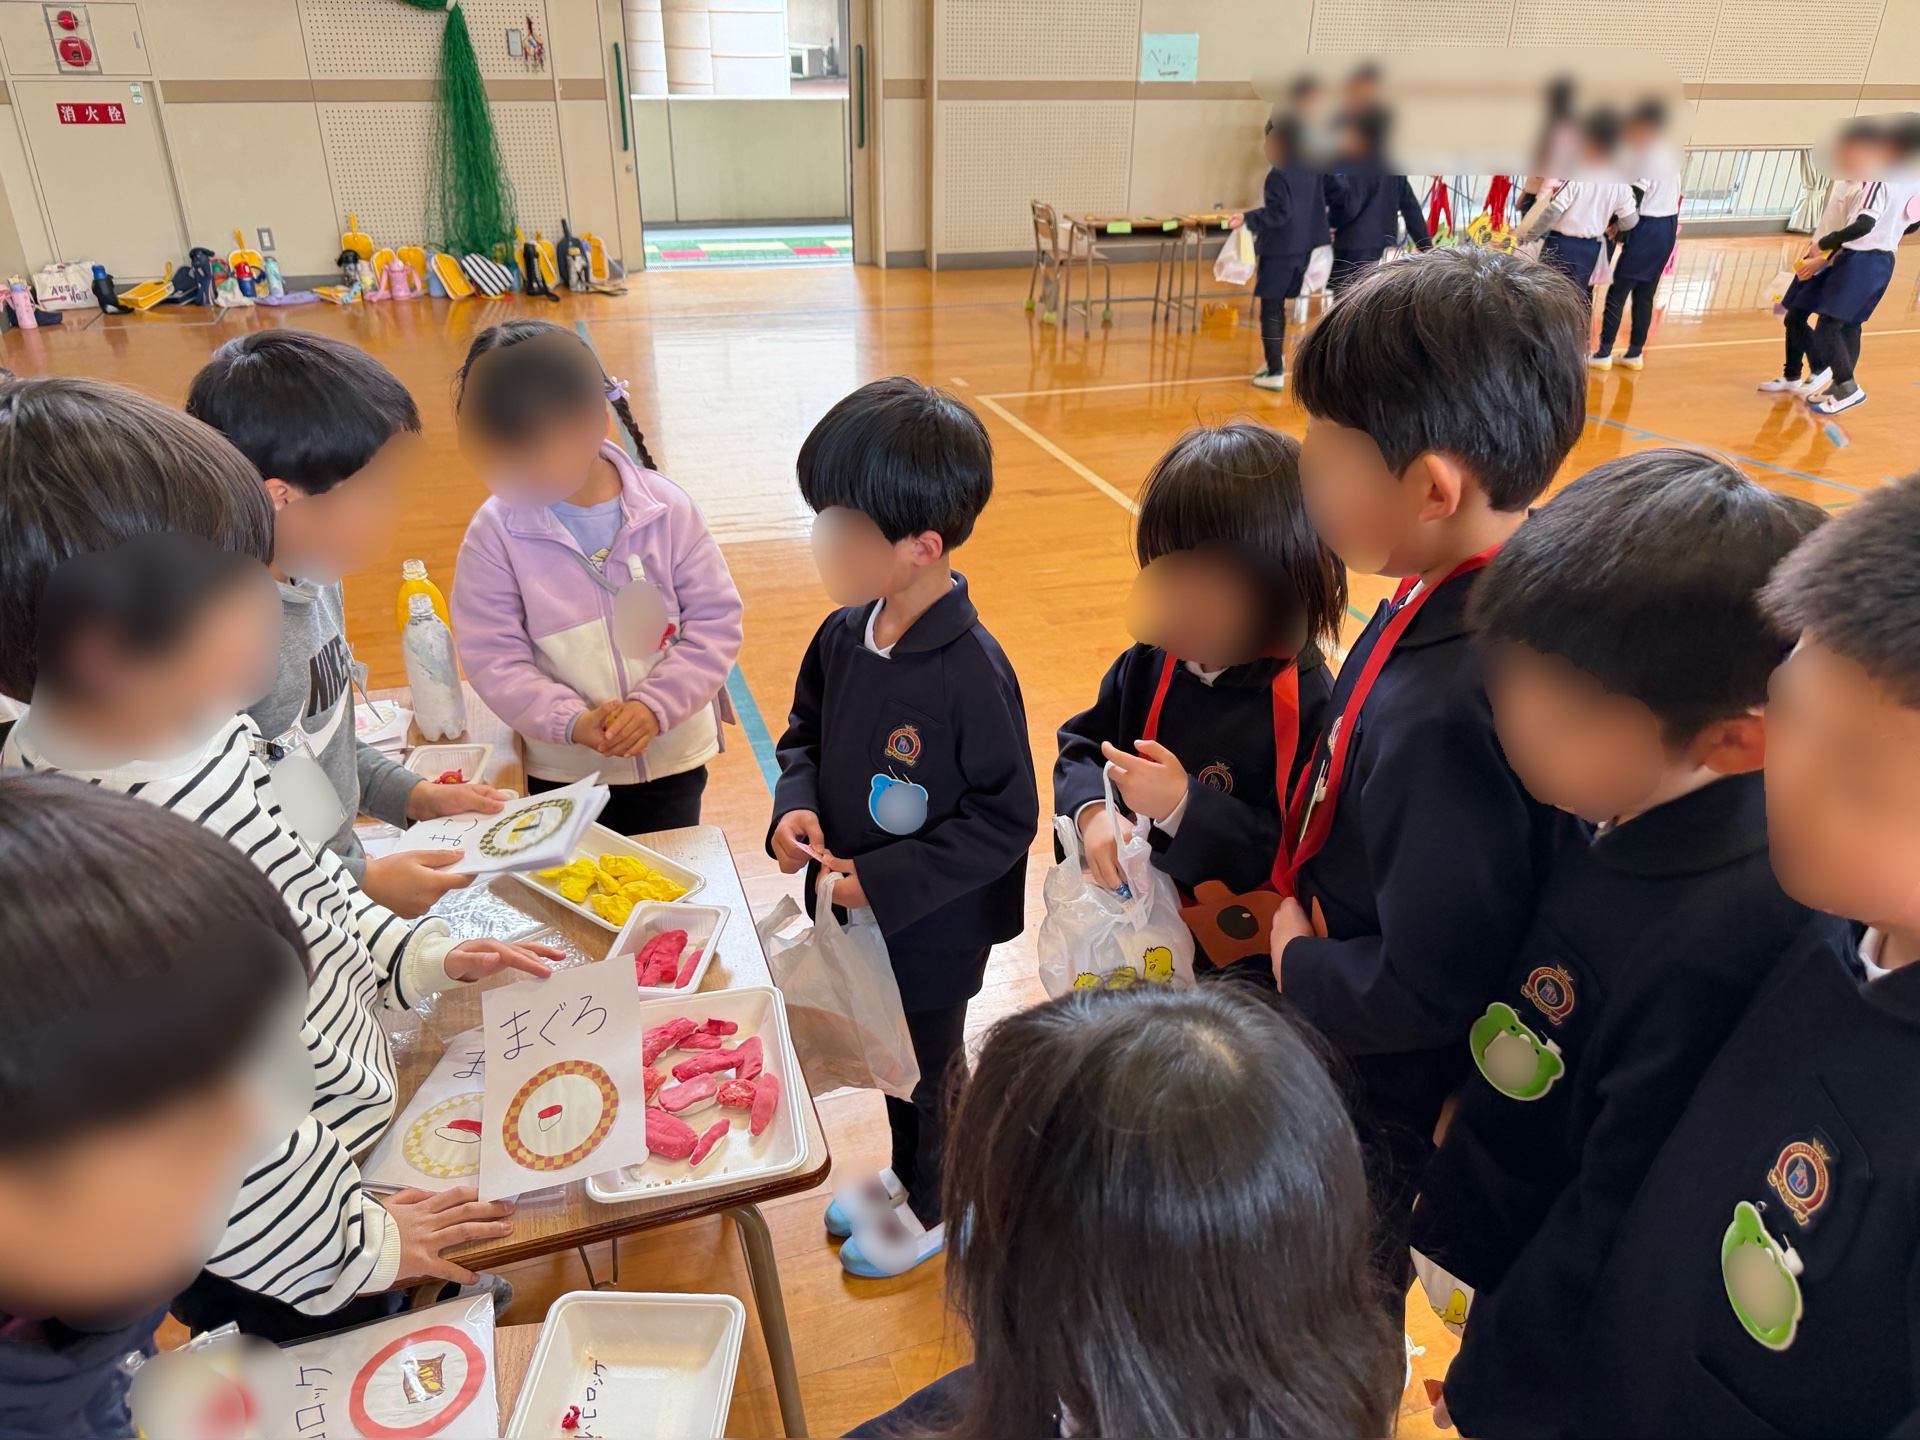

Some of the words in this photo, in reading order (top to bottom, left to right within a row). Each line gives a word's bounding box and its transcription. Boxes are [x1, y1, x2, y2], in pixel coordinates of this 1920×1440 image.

[60, 105, 123, 122] 消火栓
[307, 633, 348, 718] NIKE
[500, 995, 607, 1060] まぐろ
